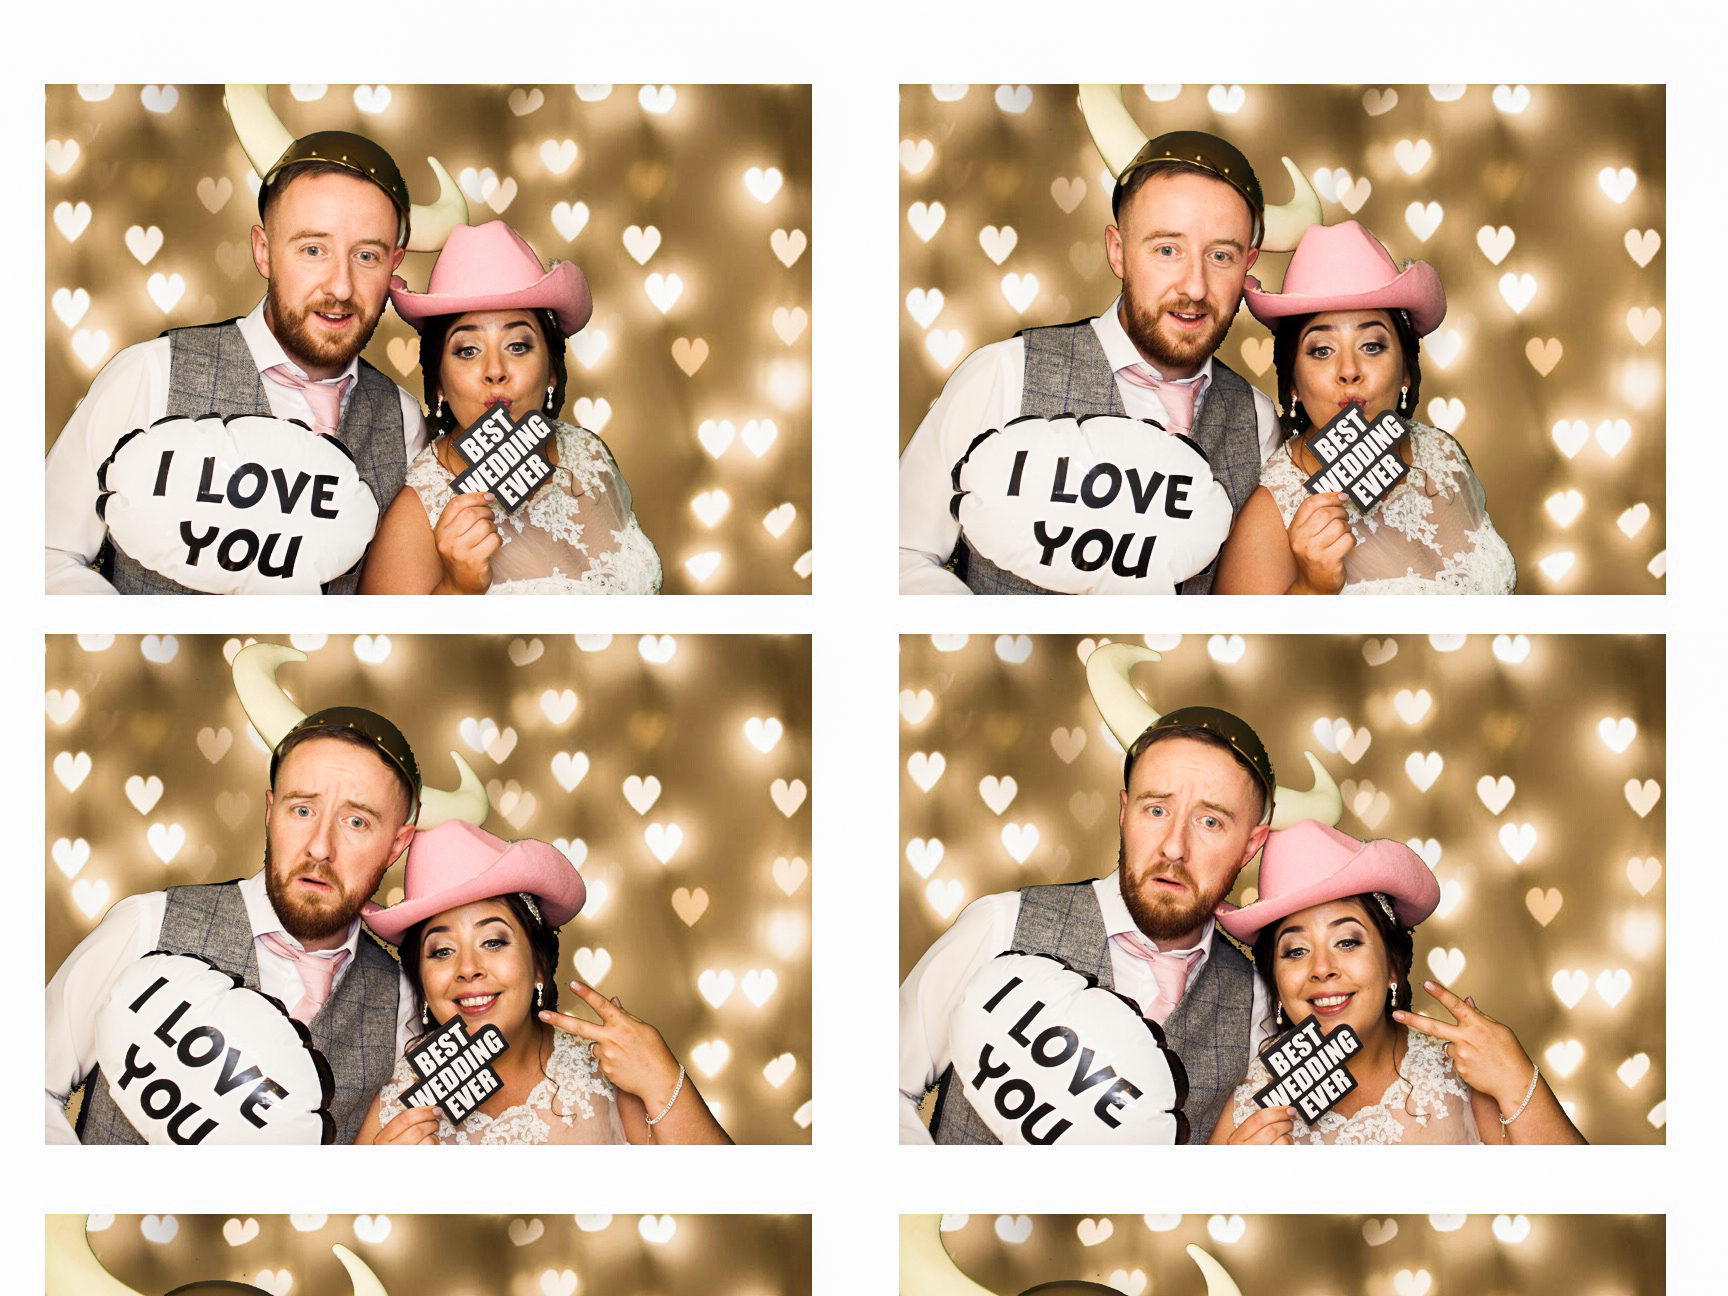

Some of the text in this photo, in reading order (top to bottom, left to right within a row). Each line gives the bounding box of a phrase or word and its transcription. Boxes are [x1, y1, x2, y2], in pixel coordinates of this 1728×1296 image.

[458, 414, 551, 494] WEDDING
[459, 407, 513, 464] BEST
[1312, 414, 1405, 494] WEDDING
[1313, 407, 1367, 464] BEST
[152, 450, 340, 519] I LOVE
[496, 453, 550, 507] EVER
[1006, 450, 1194, 519] I LOVE
[1350, 453, 1404, 507] EVER
[179, 520, 304, 579] YOU
[1033, 520, 1158, 579] YOU
[128, 976, 289, 1130] I LOVE
[407, 1029, 504, 1108] WEDDING
[413, 1021, 469, 1078] BEST
[982, 976, 1143, 1130] I LOVE
[1261, 1029, 1358, 1108] WEDDING
[1267, 1021, 1323, 1078] BEST
[117, 1042, 220, 1146] YOU
[444, 1068, 499, 1120] EVER
[971, 1042, 1074, 1146] YOU
[1298, 1068, 1353, 1120] EVER
